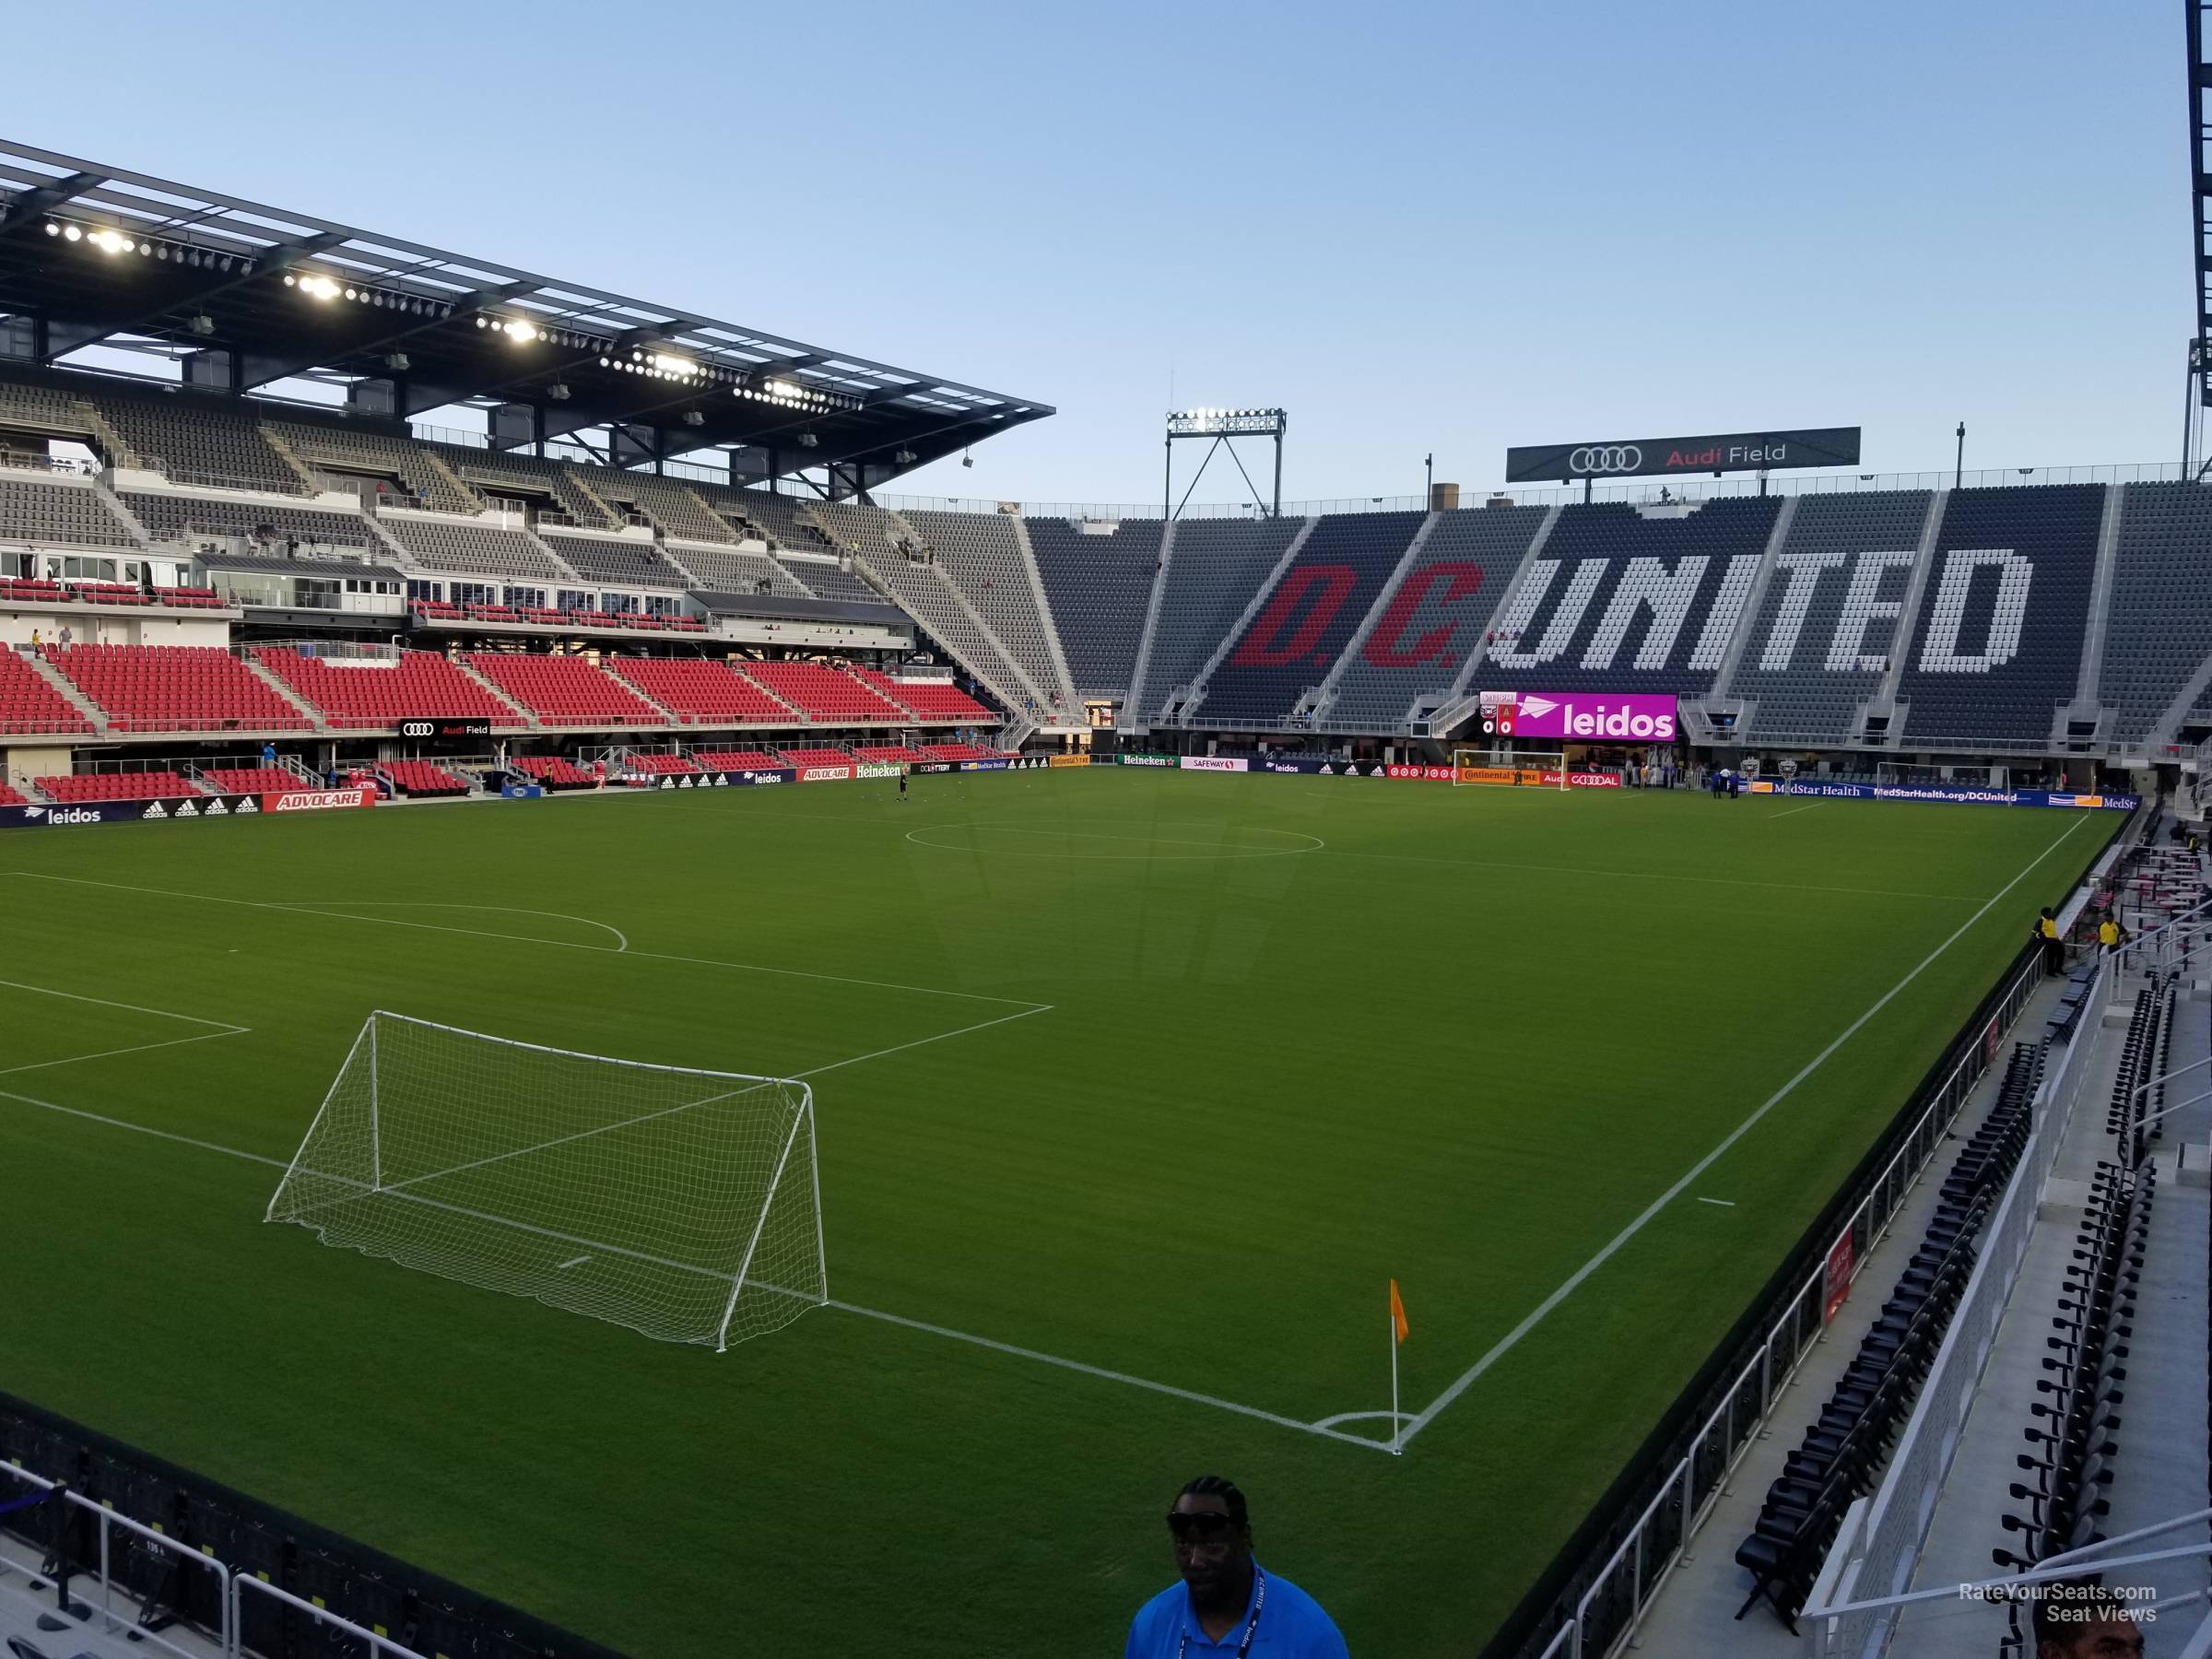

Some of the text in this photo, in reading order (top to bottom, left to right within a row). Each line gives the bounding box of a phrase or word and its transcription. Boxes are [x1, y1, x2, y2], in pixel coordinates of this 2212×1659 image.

[1665, 442, 1786, 467] Audi Field
[1487, 550, 2034, 672] UNITED
[1563, 703, 1674, 737] leidos
[442, 725, 488, 735] Audi Field
[1483, 721, 1493, 734] 0
[1500, 721, 1512, 734] 0
[1124, 755, 1166, 766] Heineken
[1194, 759, 1225, 768] SAFEWAY
[856, 765, 900, 778] Heineken
[1275, 763, 1299, 772] leidos
[755, 772, 782, 784] leidos
[803, 768, 850, 782] ADVOCARE
[1465, 771, 1509, 781] Continental
[1774, 785, 1860, 796] MdStar Health
[276, 791, 363, 811] ADVOCARE
[48, 807, 101, 825] leidos
